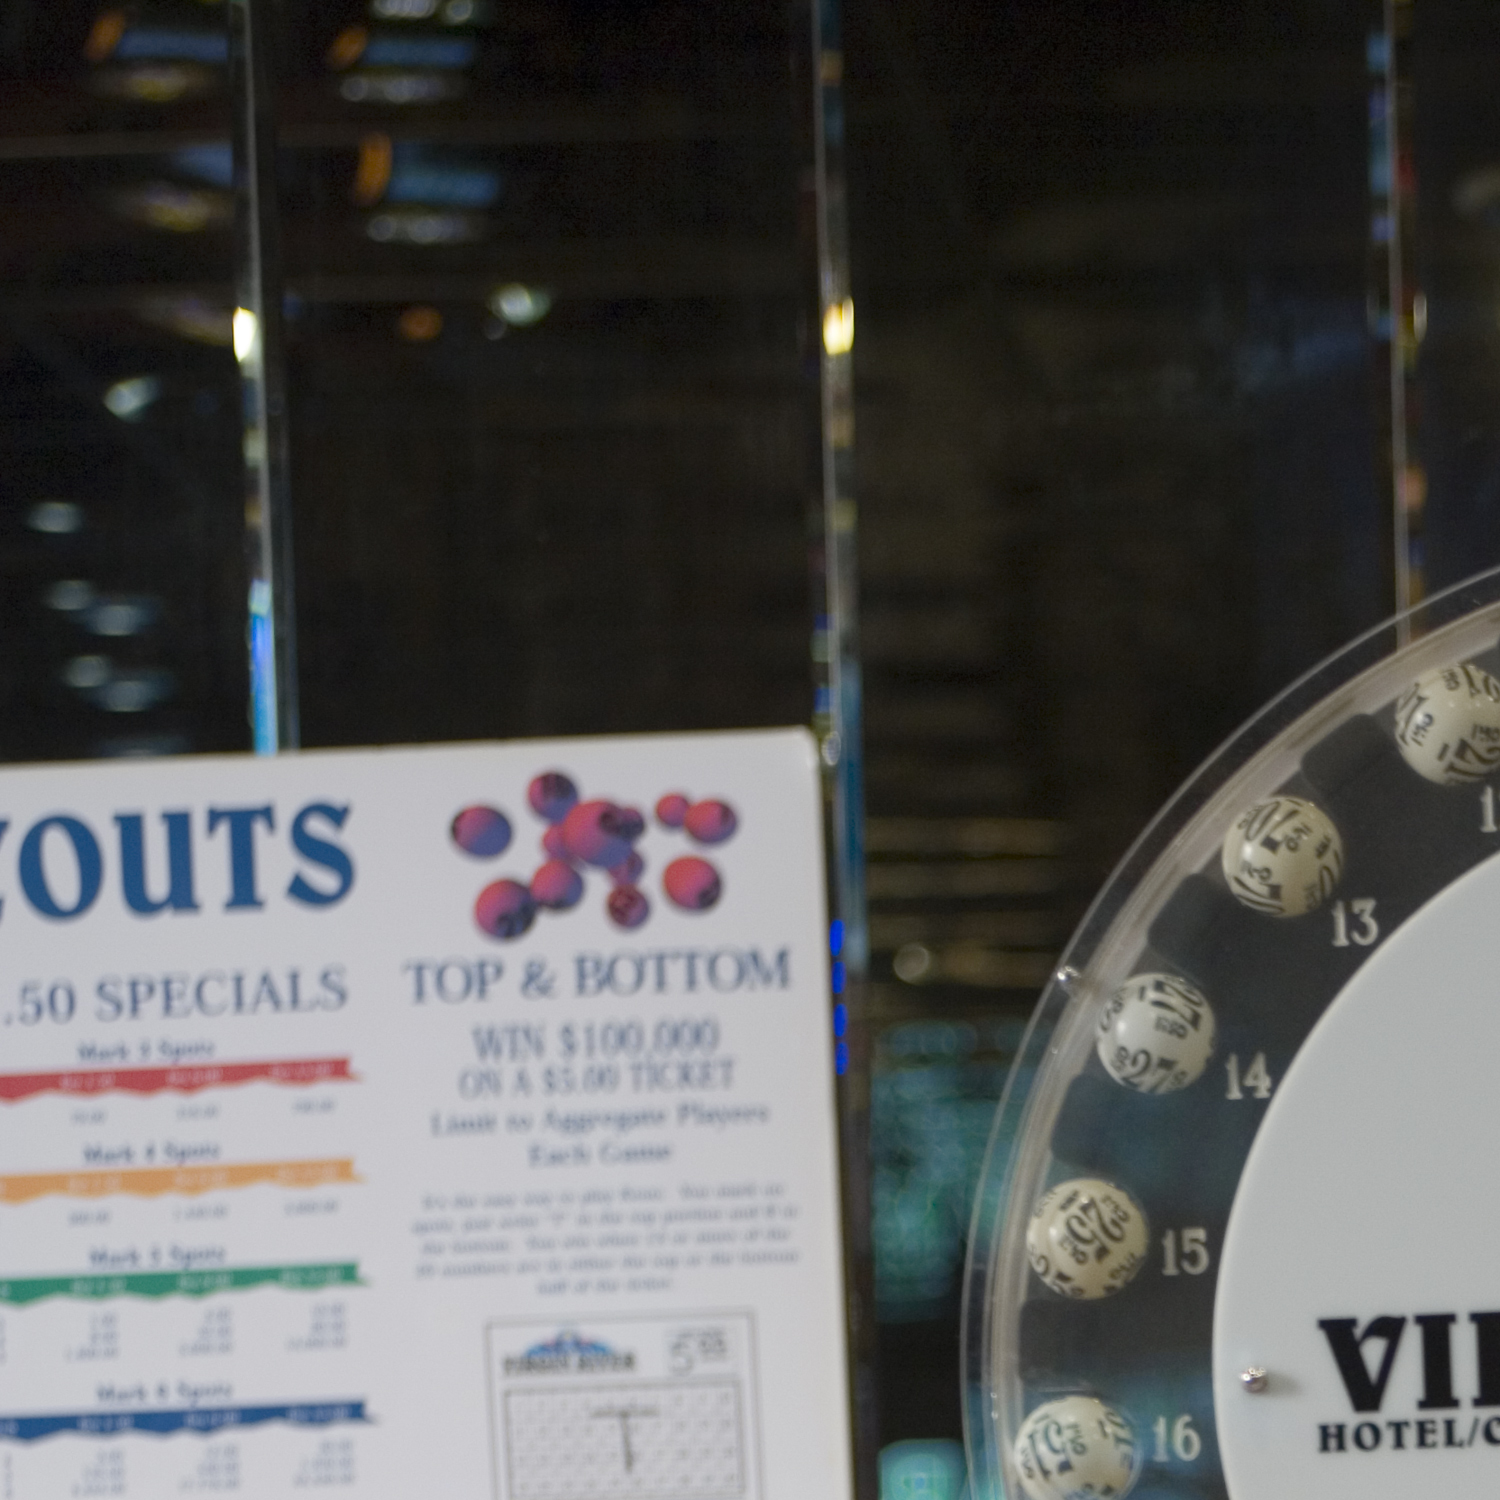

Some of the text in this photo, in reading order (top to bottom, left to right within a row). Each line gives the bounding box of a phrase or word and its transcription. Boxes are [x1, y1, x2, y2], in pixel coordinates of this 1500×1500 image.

[0, 802, 356, 922] OUTS
[1332, 899, 1378, 947] 13
[95, 965, 349, 1021] SPECIALS
[403, 948, 792, 1005] TOP & BOTTOM
[472, 1022, 545, 1062] WIN
[459, 1067, 503, 1098] ON
[514, 1065, 532, 1096] A
[629, 1056, 735, 1092] TICKET
[1225, 1051, 1271, 1099] 14
[1162, 1229, 1209, 1276] 15
[591, 1404, 660, 1474] T
[1153, 1415, 1201, 1463] 16
